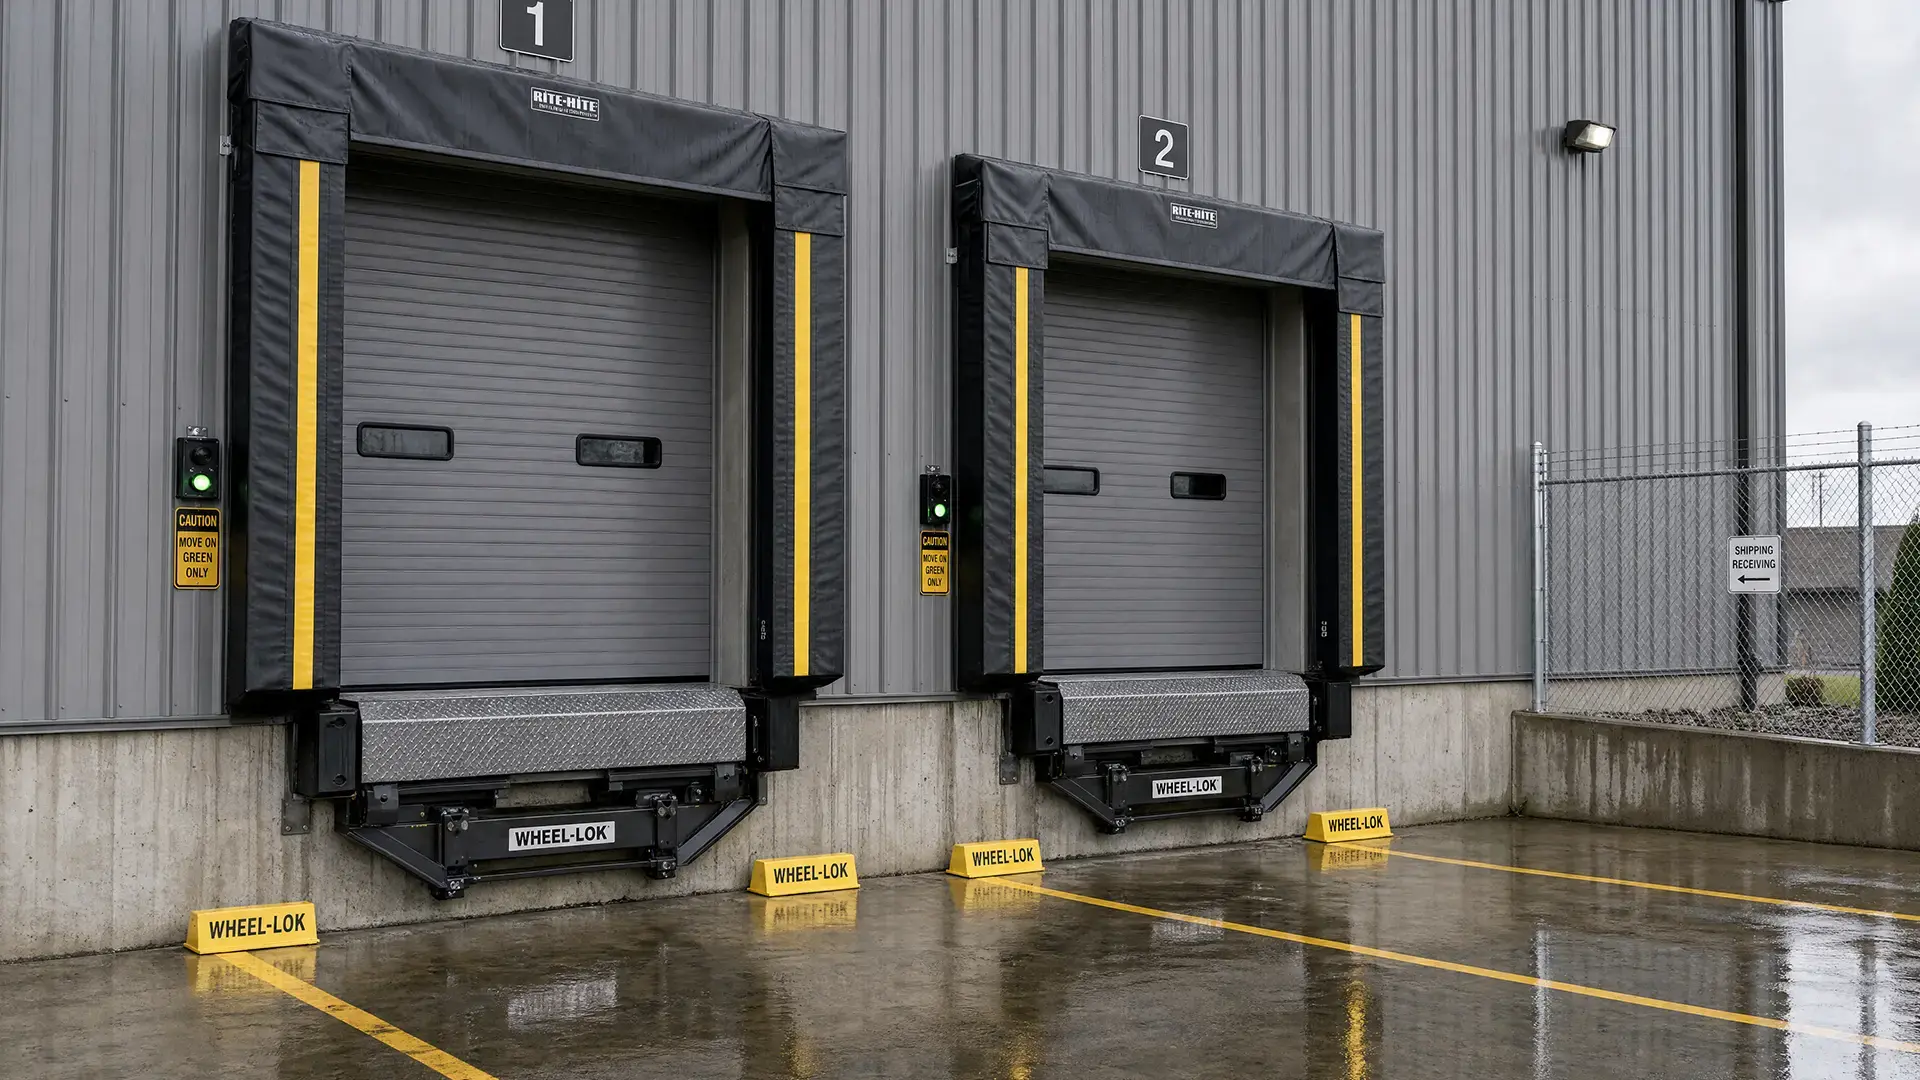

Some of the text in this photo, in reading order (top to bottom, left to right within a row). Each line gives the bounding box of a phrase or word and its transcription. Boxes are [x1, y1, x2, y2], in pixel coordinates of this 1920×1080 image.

[527, 1, 544, 46] 1
[1155, 129, 1174, 168] 2
[1172, 205, 1216, 221] RITE-HITE
[179, 514, 217, 527] CAUTION
[179, 537, 217, 548] MOVE ON
[923, 536, 948, 546] CAUTION
[1734, 545, 1774, 555] SHIPPING
[183, 551, 213, 563] GREEN
[923, 554, 947, 563] MOVE ON
[925, 565, 945, 575] GREEN
[1732, 559, 1776, 569] RECEIVING
[185, 567, 209, 578] ONLY
[927, 577, 943, 587] ONLY
[1156, 779, 1217, 795] WHEEL-LOK
[1328, 815, 1384, 833] WHEEL-LOK
[515, 825, 608, 847] WHEEL-LOK
[972, 847, 1035, 867] WHEEL-LOK
[773, 862, 849, 884] WHEEL-LOK
[209, 913, 306, 939] WHEEL-LOK
